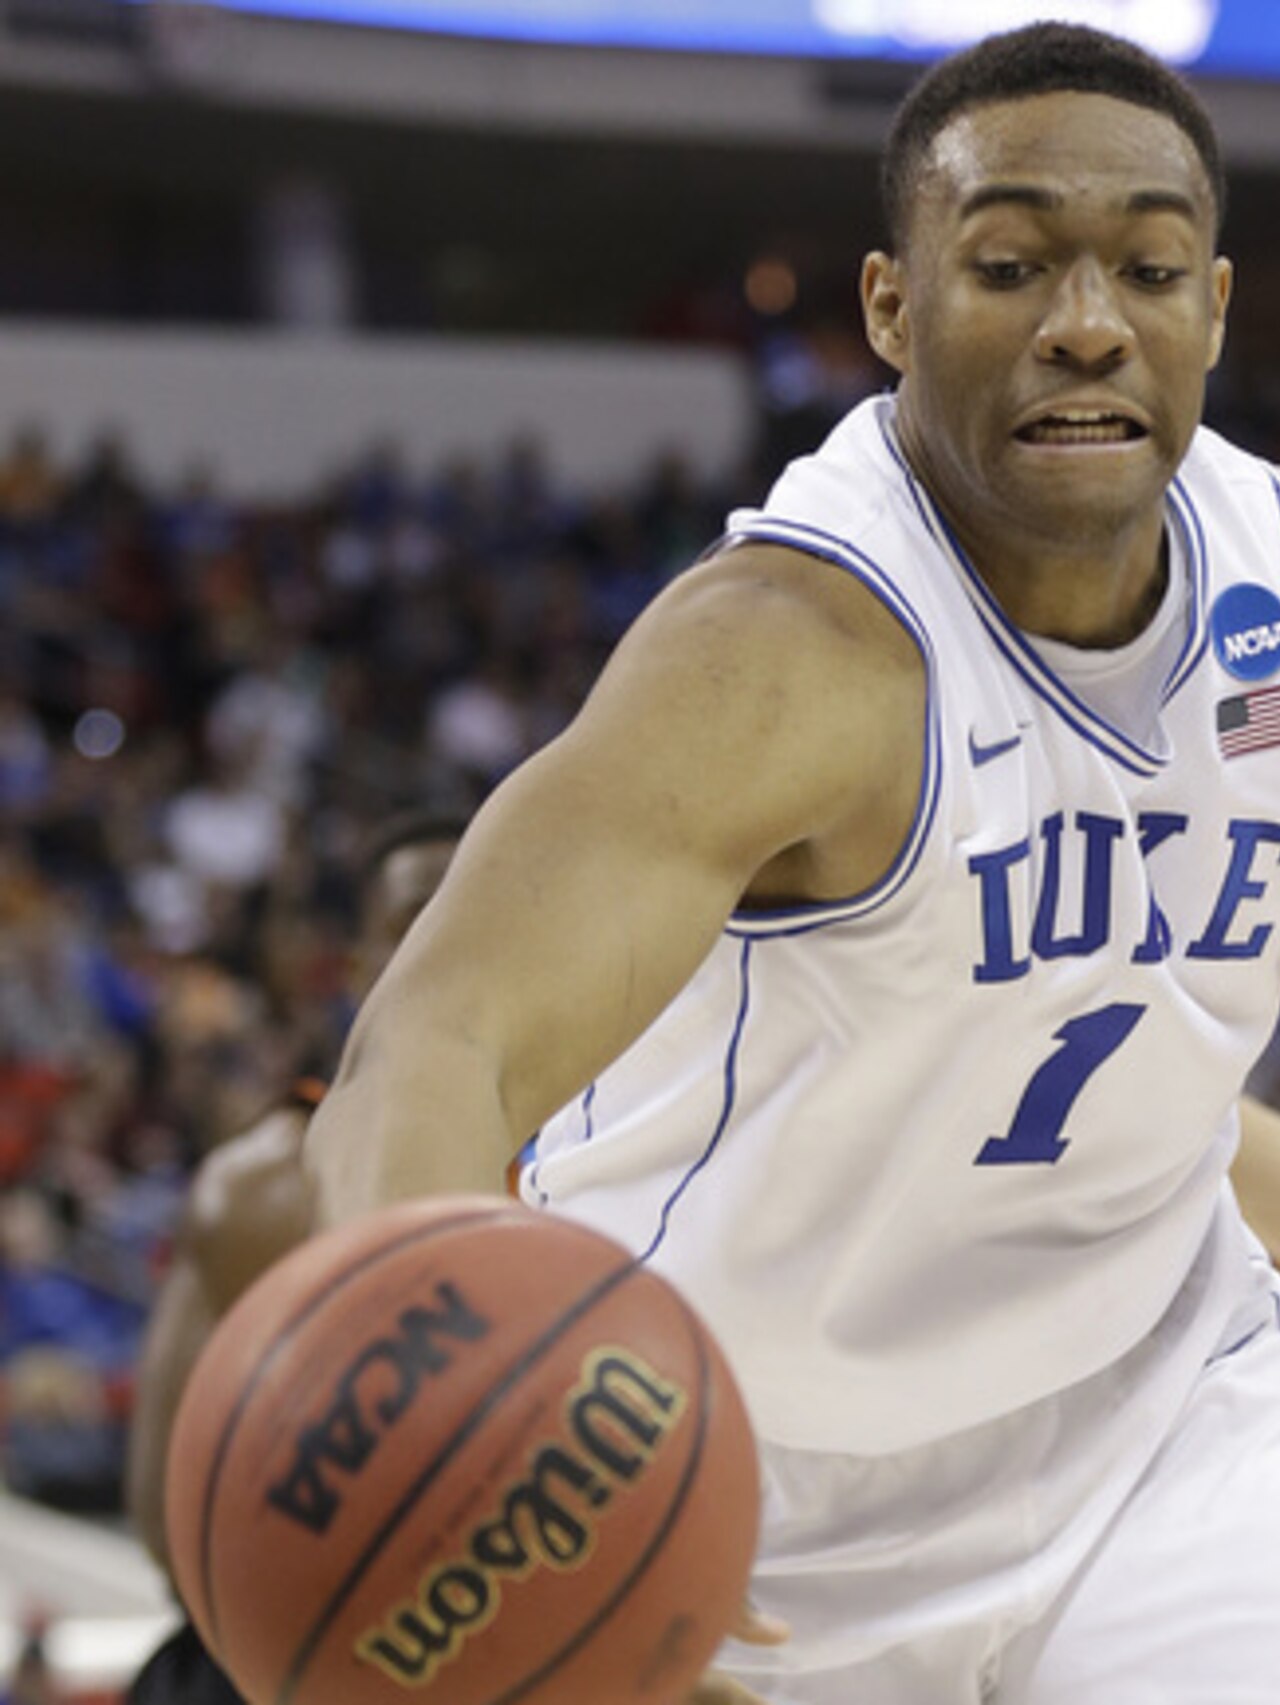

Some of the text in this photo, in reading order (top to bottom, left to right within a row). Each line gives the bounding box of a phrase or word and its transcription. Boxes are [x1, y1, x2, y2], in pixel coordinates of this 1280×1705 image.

[973, 1003, 1148, 1165] 1
[266, 1280, 491, 1536] NCAA
[356, 1344, 686, 1686] Wilson
